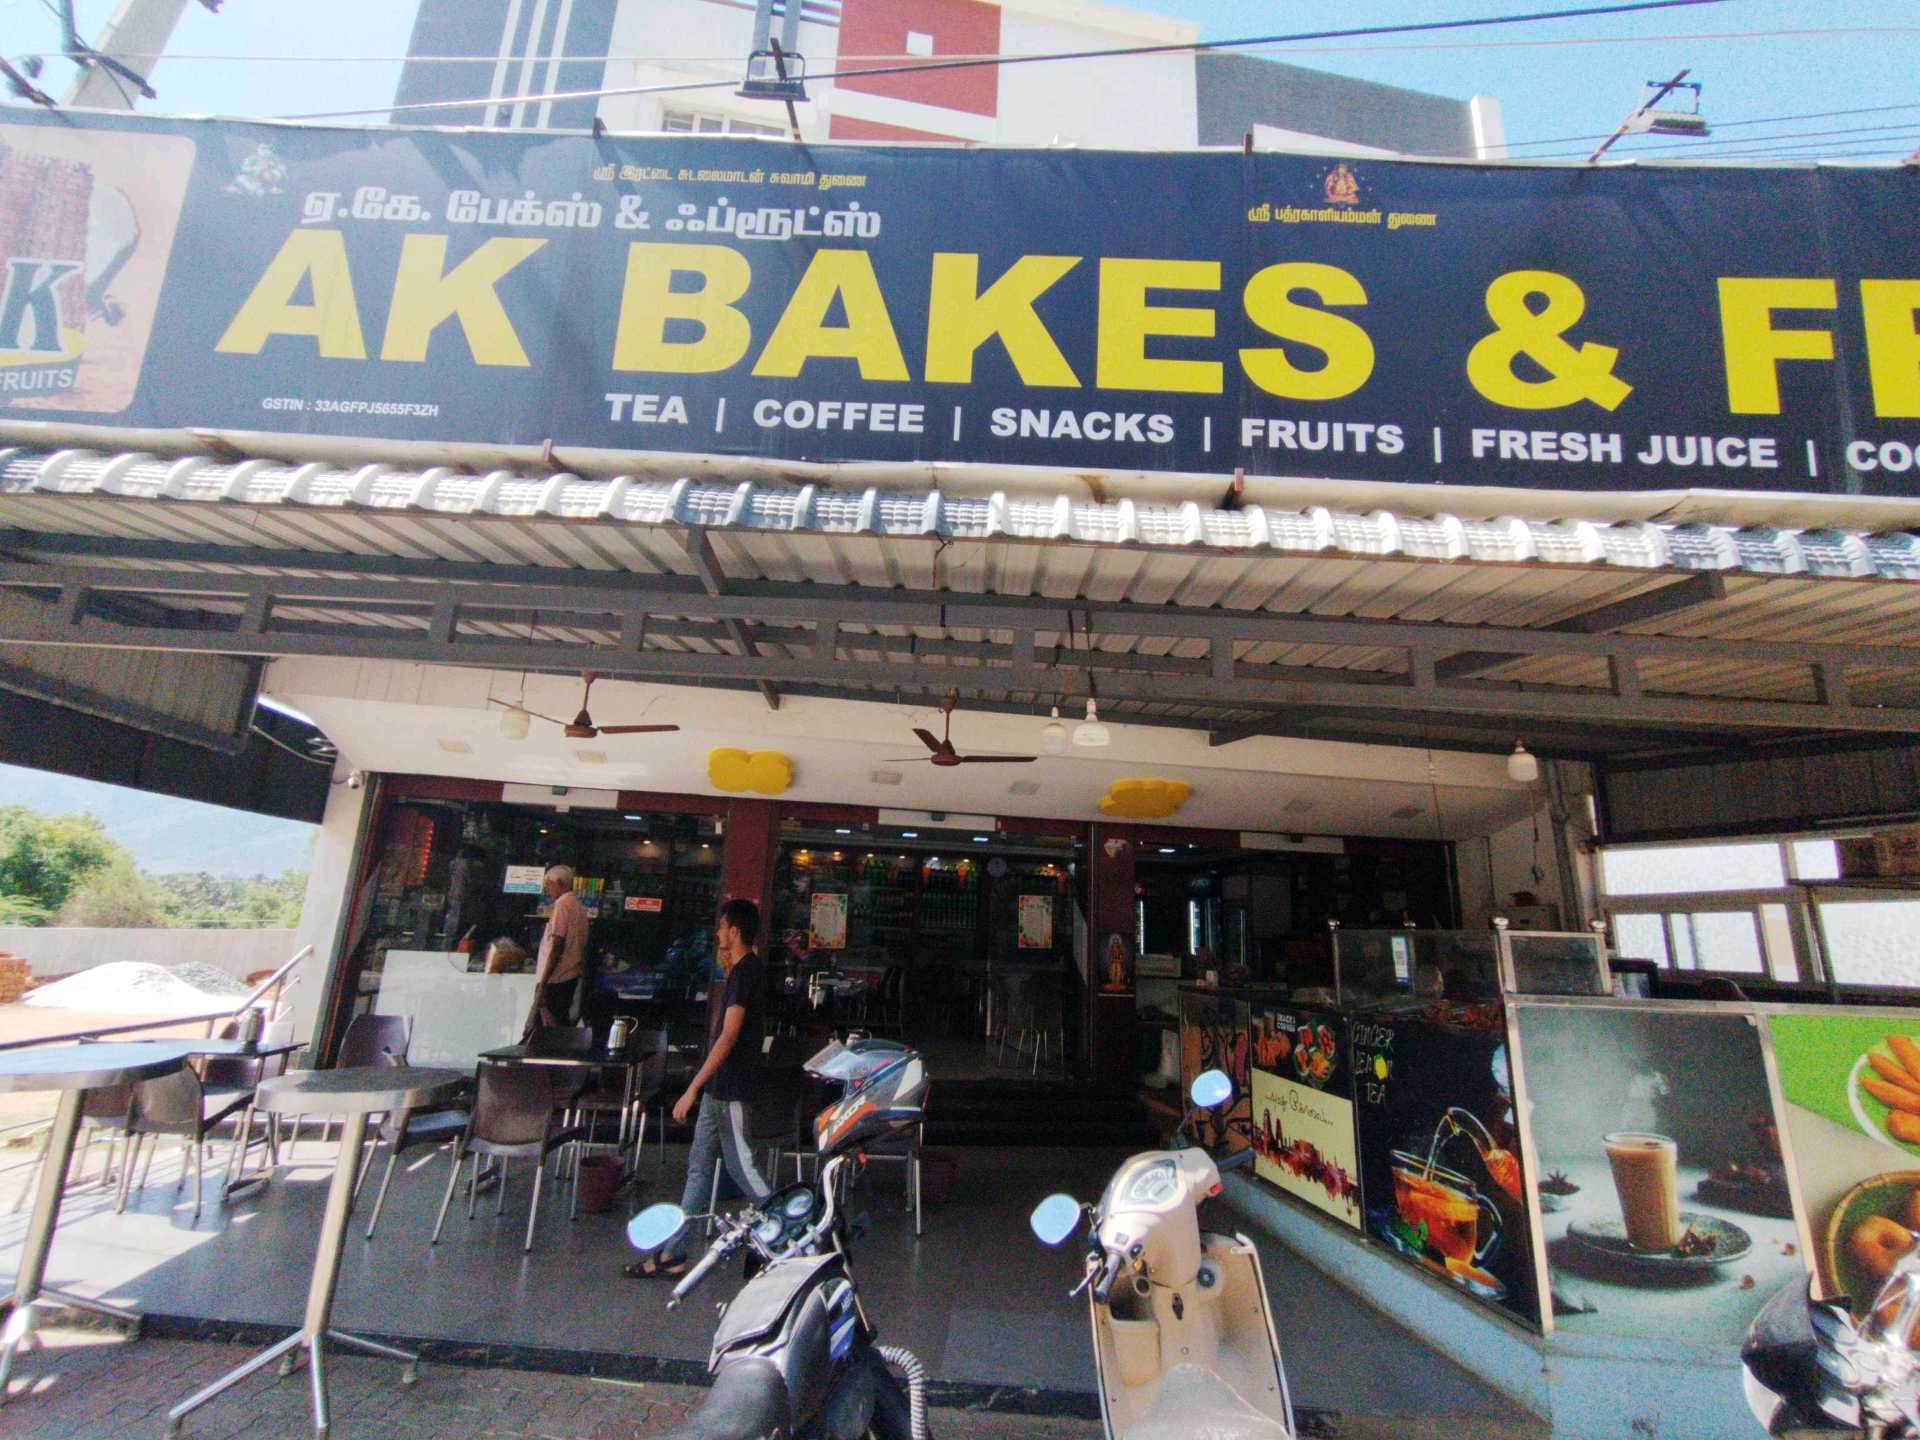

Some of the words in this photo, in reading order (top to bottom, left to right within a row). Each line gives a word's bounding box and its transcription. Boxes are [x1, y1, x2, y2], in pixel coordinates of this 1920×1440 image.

[818, 173, 868, 191] துணை
[446, 189, 603, 228] பேக்ஸ்
[613, 193, 650, 230] &
[1386, 212, 1438, 231] துணை
[214, 229, 548, 367] AK
[612, 242, 1375, 402] BAKES
[1466, 269, 1634, 412] &
[262, 397, 304, 412] GSTIN
[605, 393, 689, 424] TEA
[753, 399, 925, 433] COFFEE
[991, 407, 1174, 443] SNACKS
[1241, 418, 1404, 454] FRUITS
[1471, 429, 1622, 462] FRESH
[1637, 436, 1778, 468] JUICE
[1847, 440, 1920, 472] CO
